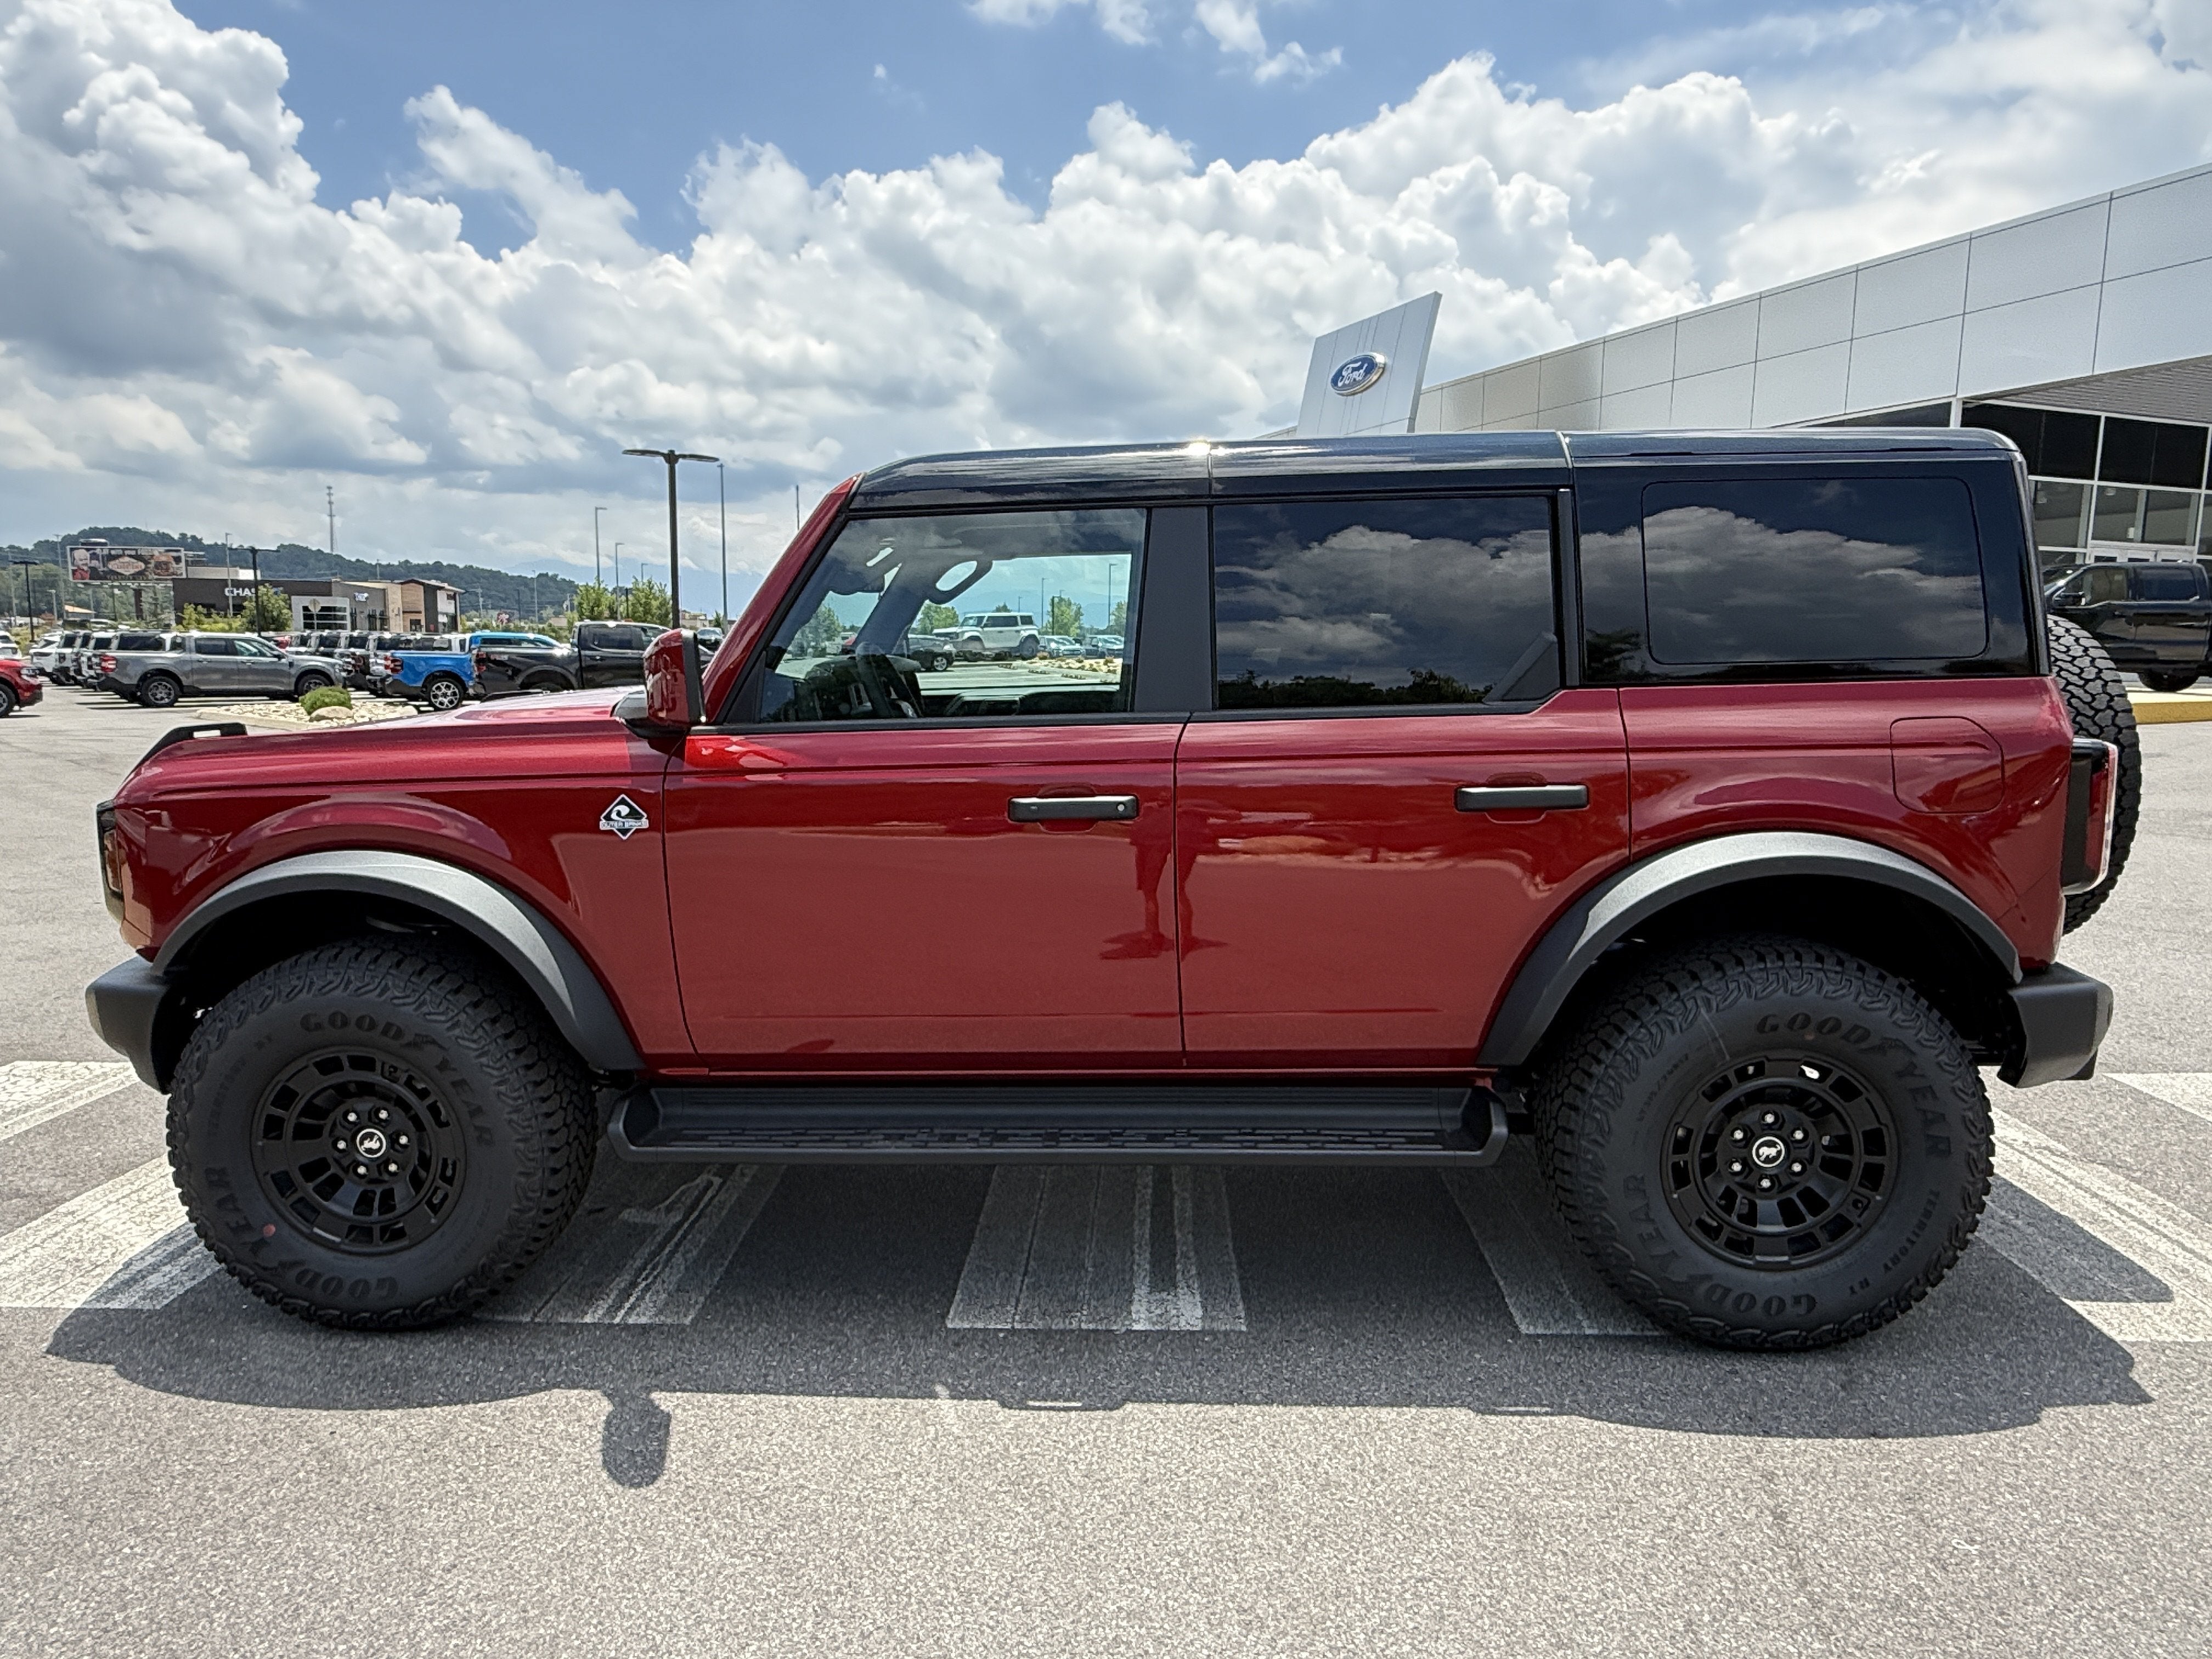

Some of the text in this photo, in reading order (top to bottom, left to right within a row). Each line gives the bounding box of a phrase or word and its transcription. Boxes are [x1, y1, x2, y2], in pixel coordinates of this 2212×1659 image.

[1338, 361, 1368, 387] Ford
[224, 587, 256, 597] CHAS
[1757, 1013, 1951, 1159] GOODYEAR
[1623, 1175, 1816, 1317] GOODYEAR
[1883, 1188, 1940, 1274] TERRITORY
